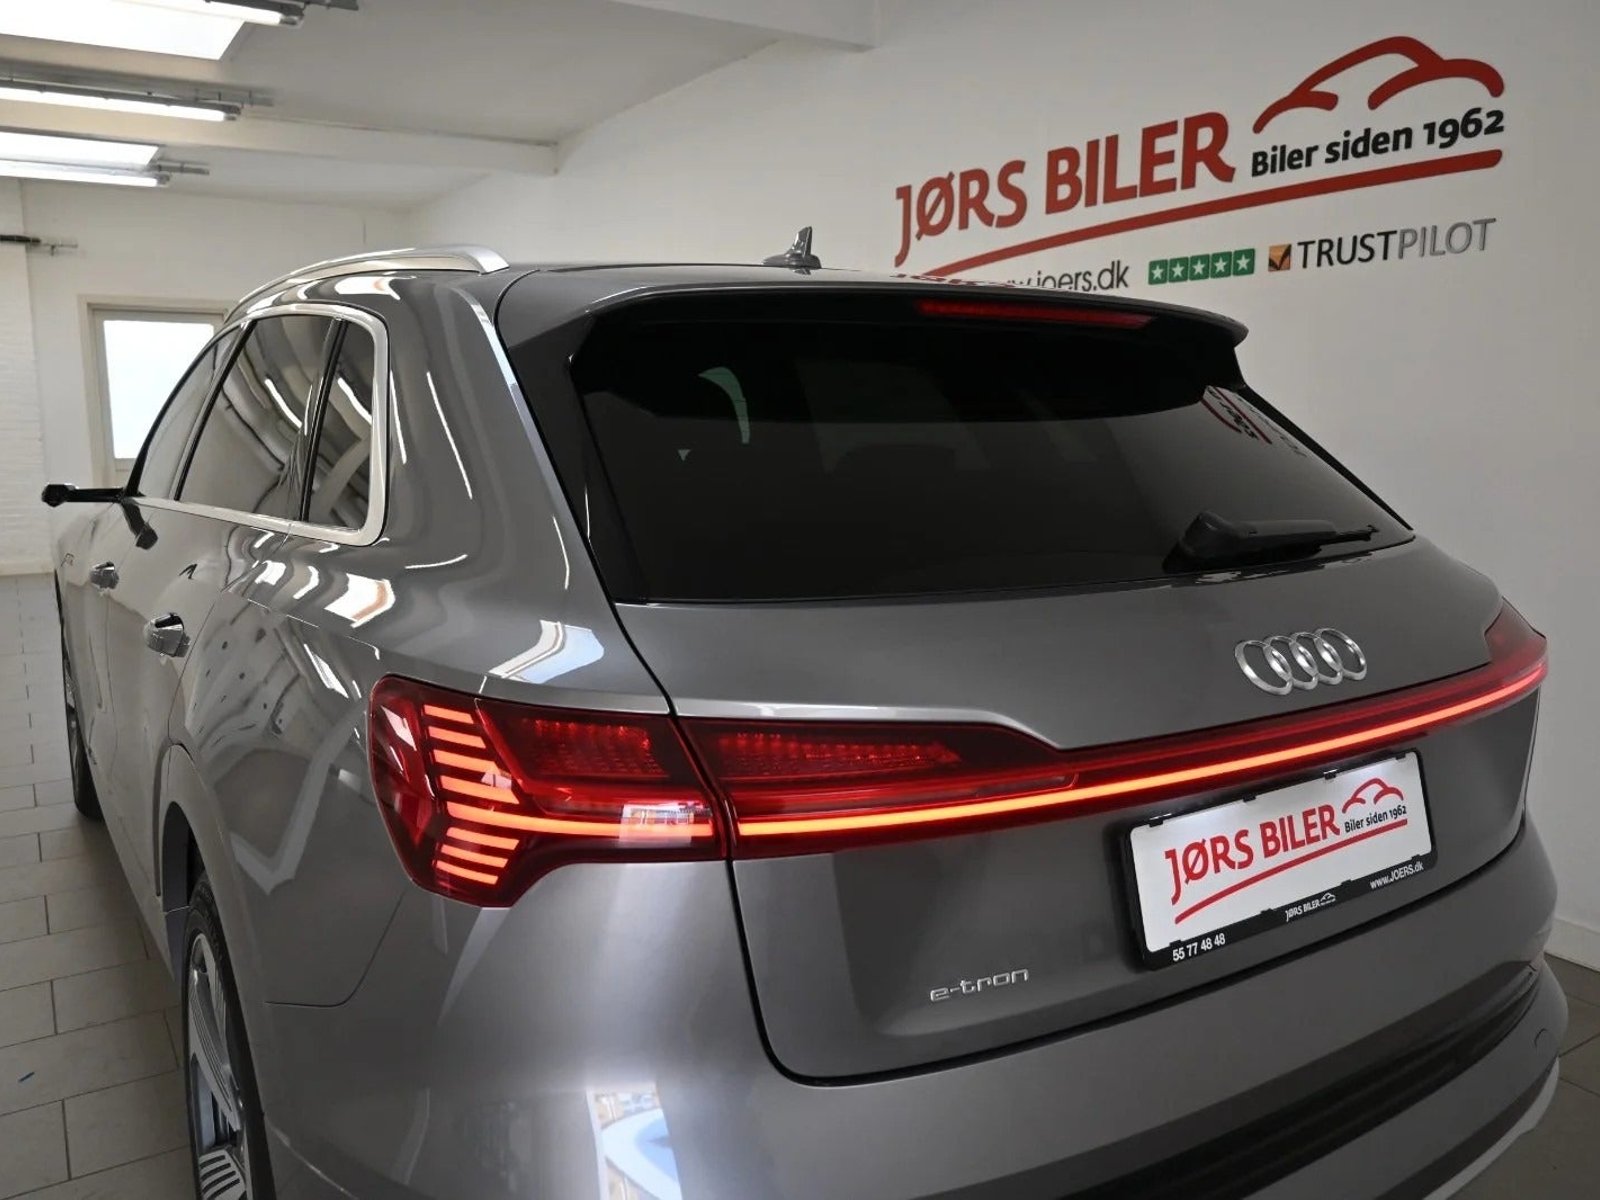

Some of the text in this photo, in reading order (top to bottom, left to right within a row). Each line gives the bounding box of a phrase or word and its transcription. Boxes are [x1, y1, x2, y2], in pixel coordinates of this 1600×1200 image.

[1251, 107, 1505, 177] Biler siden 1962
[894, 111, 1236, 268] JØRS BILER
[1297, 217, 1497, 269] TRUSTPILOT
[1344, 804, 1407, 833] Biler siden 1962
[1164, 804, 1341, 906] JØRS BILER
[1369, 861, 1425, 890] www.JOERS.dk
[1303, 898, 1321, 913] BILER
[1172, 932, 1226, 962] 55 77 48 48
[930, 968, 1030, 1003] e-tron
